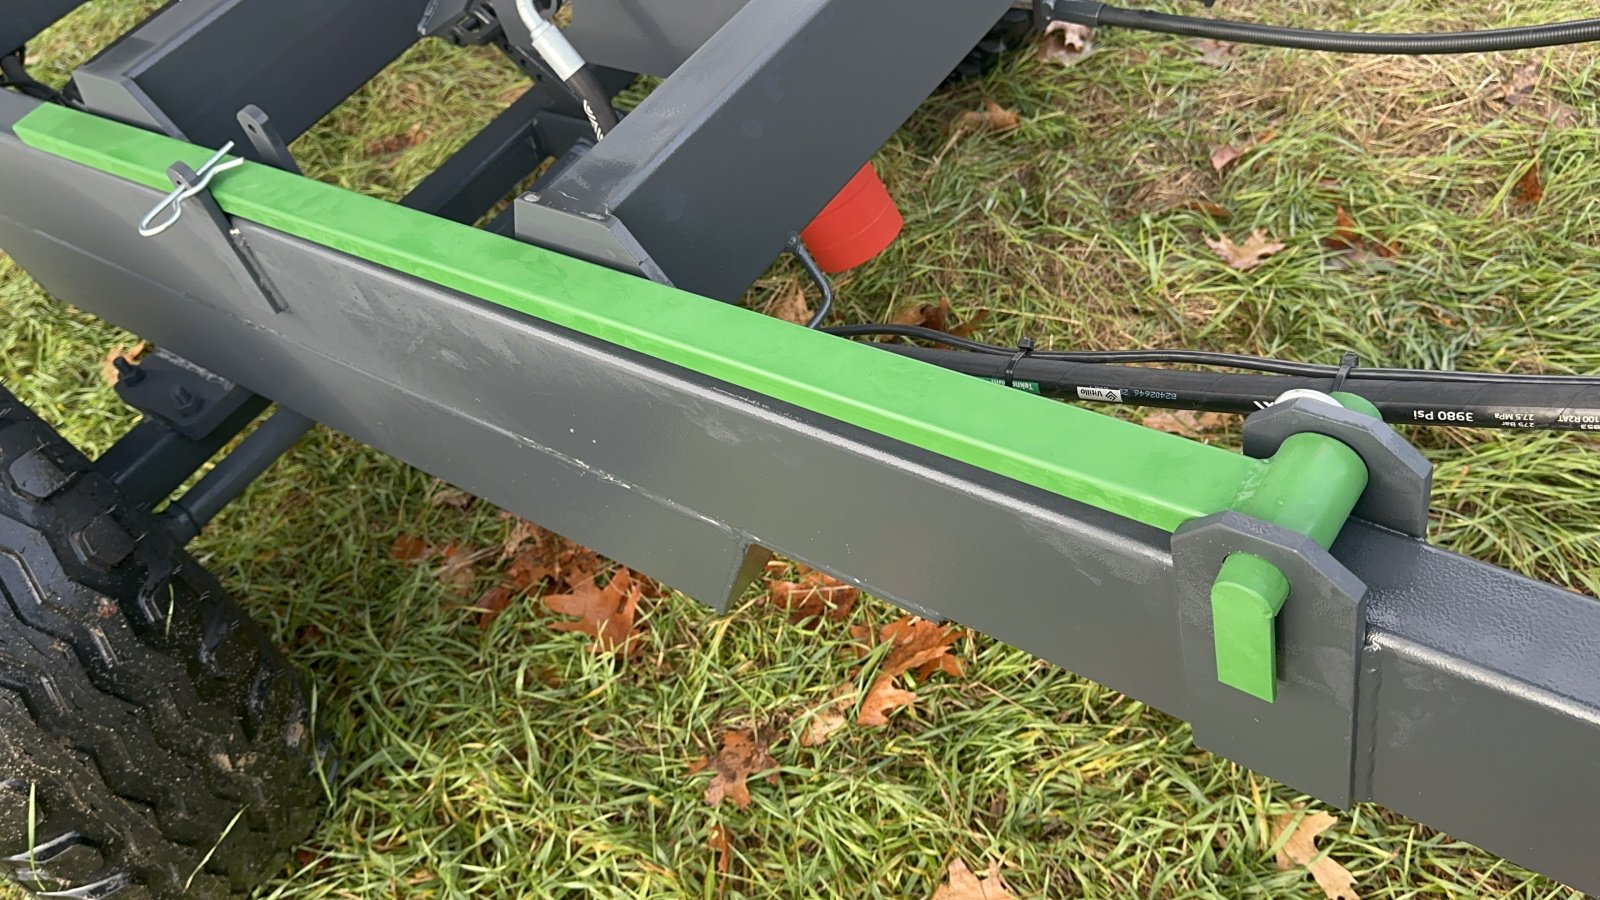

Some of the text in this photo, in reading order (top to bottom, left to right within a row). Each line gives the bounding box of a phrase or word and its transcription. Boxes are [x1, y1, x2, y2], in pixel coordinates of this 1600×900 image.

[1081, 388, 1103, 398] Vitillo
[1413, 410, 1474, 422] 3980 Psi
[1494, 412, 1535, 421] 27.5 MPa
[1557, 415, 1600, 423] 100 R2AT
